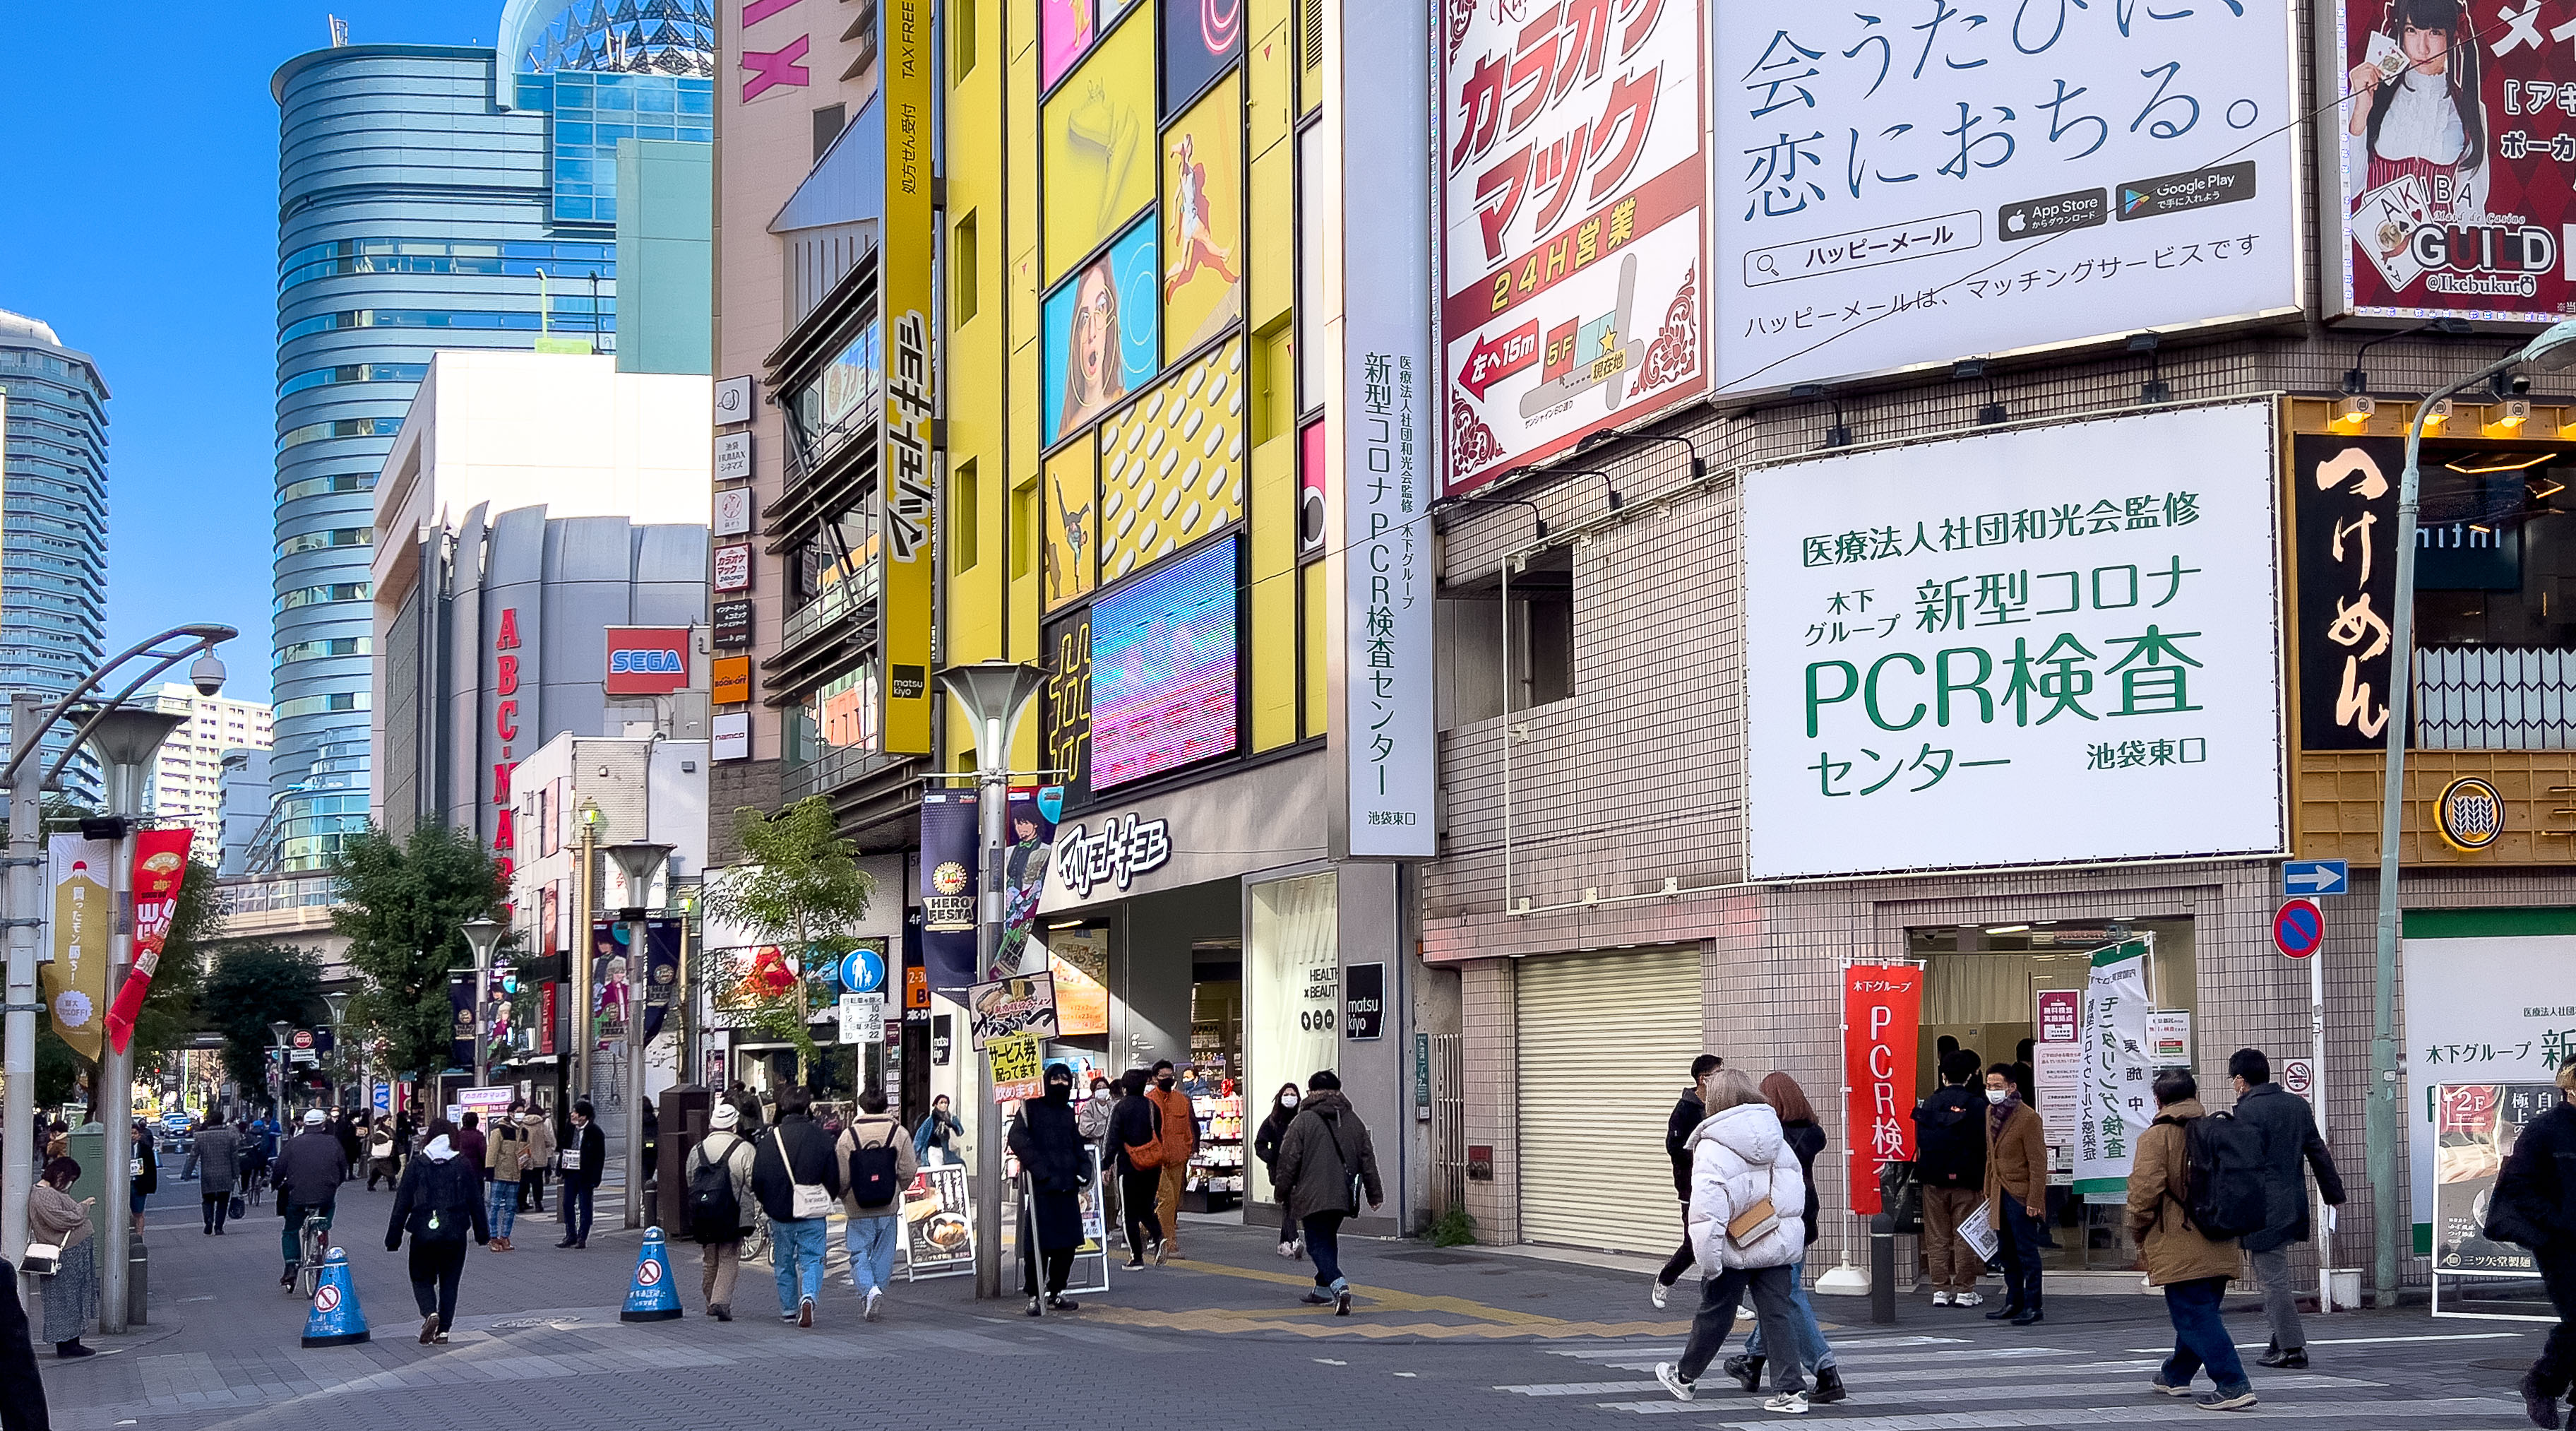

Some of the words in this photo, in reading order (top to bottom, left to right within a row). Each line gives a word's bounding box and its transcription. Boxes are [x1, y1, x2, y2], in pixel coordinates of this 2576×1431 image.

[902, 1, 916, 46] FREE
[902, 50, 916, 79] TAX
[902, 102, 917, 196] 処方せん受付
[1743, 61, 2260, 222] 恋におちる。
[1473, 59, 1664, 269] マック
[2157, 176, 2206, 198] Google
[2208, 172, 2236, 194] Play
[2157, 189, 2222, 210] で手に入れよう
[2380, 174, 2474, 222] AKIBA
[2031, 210, 2097, 230] からダウンロード
[2032, 201, 2062, 220] App
[2063, 194, 2099, 214] Store
[1490, 196, 1638, 313] 24H営業
[1805, 226, 1955, 270] ハッピーメール
[2412, 224, 2556, 273] GUILD
[1745, 233, 2260, 338] ハッピーメールは、マッチングサービスです
[1471, 330, 1536, 385] 左へ15m
[1546, 333, 1575, 367] 5F
[1592, 351, 1626, 381] 現在地
[1400, 355, 1413, 514] 医療法人社団和光会監修
[1803, 490, 2200, 568] 医療法人社団和光会監修
[1364, 351, 1395, 796] 新型コロナPCR検査センター
[1400, 523, 1415, 610] 木下グループ
[1826, 588, 1875, 617] 木下
[1914, 554, 2202, 634] 新型コロナ
[2315, 446, 2392, 740] つけめん
[1805, 614, 1901, 647] グループ
[610, 648, 685, 675] SEGA
[893, 675, 924, 689] matsu
[893, 687, 912, 699] kiyo
[1805, 624, 2204, 739] PCR検査
[715, 732, 745, 742] namco
[2087, 737, 2207, 771] 池袋東口
[1807, 742, 2011, 797] センター
[1368, 810, 1416, 826] 池袋東口
[929, 908, 974, 921] FESTA
[931, 898, 970, 909] HERO
[1852, 980, 1912, 992] 木下グループ
[869, 1014, 880, 1022] 22
[1347, 997, 1378, 1014] matsu
[2523, 1006, 2576, 1017] 医療法人社団
[1347, 1015, 1367, 1037] kiyo
[989, 1038, 1037, 1067] サービス券
[2425, 1040, 2532, 1065] 木下グループ
[995, 1062, 1037, 1082] 配ってます
[2456, 1091, 2486, 1112] 2F
[2463, 1255, 2532, 1269] 三ツ矢堂製麺
